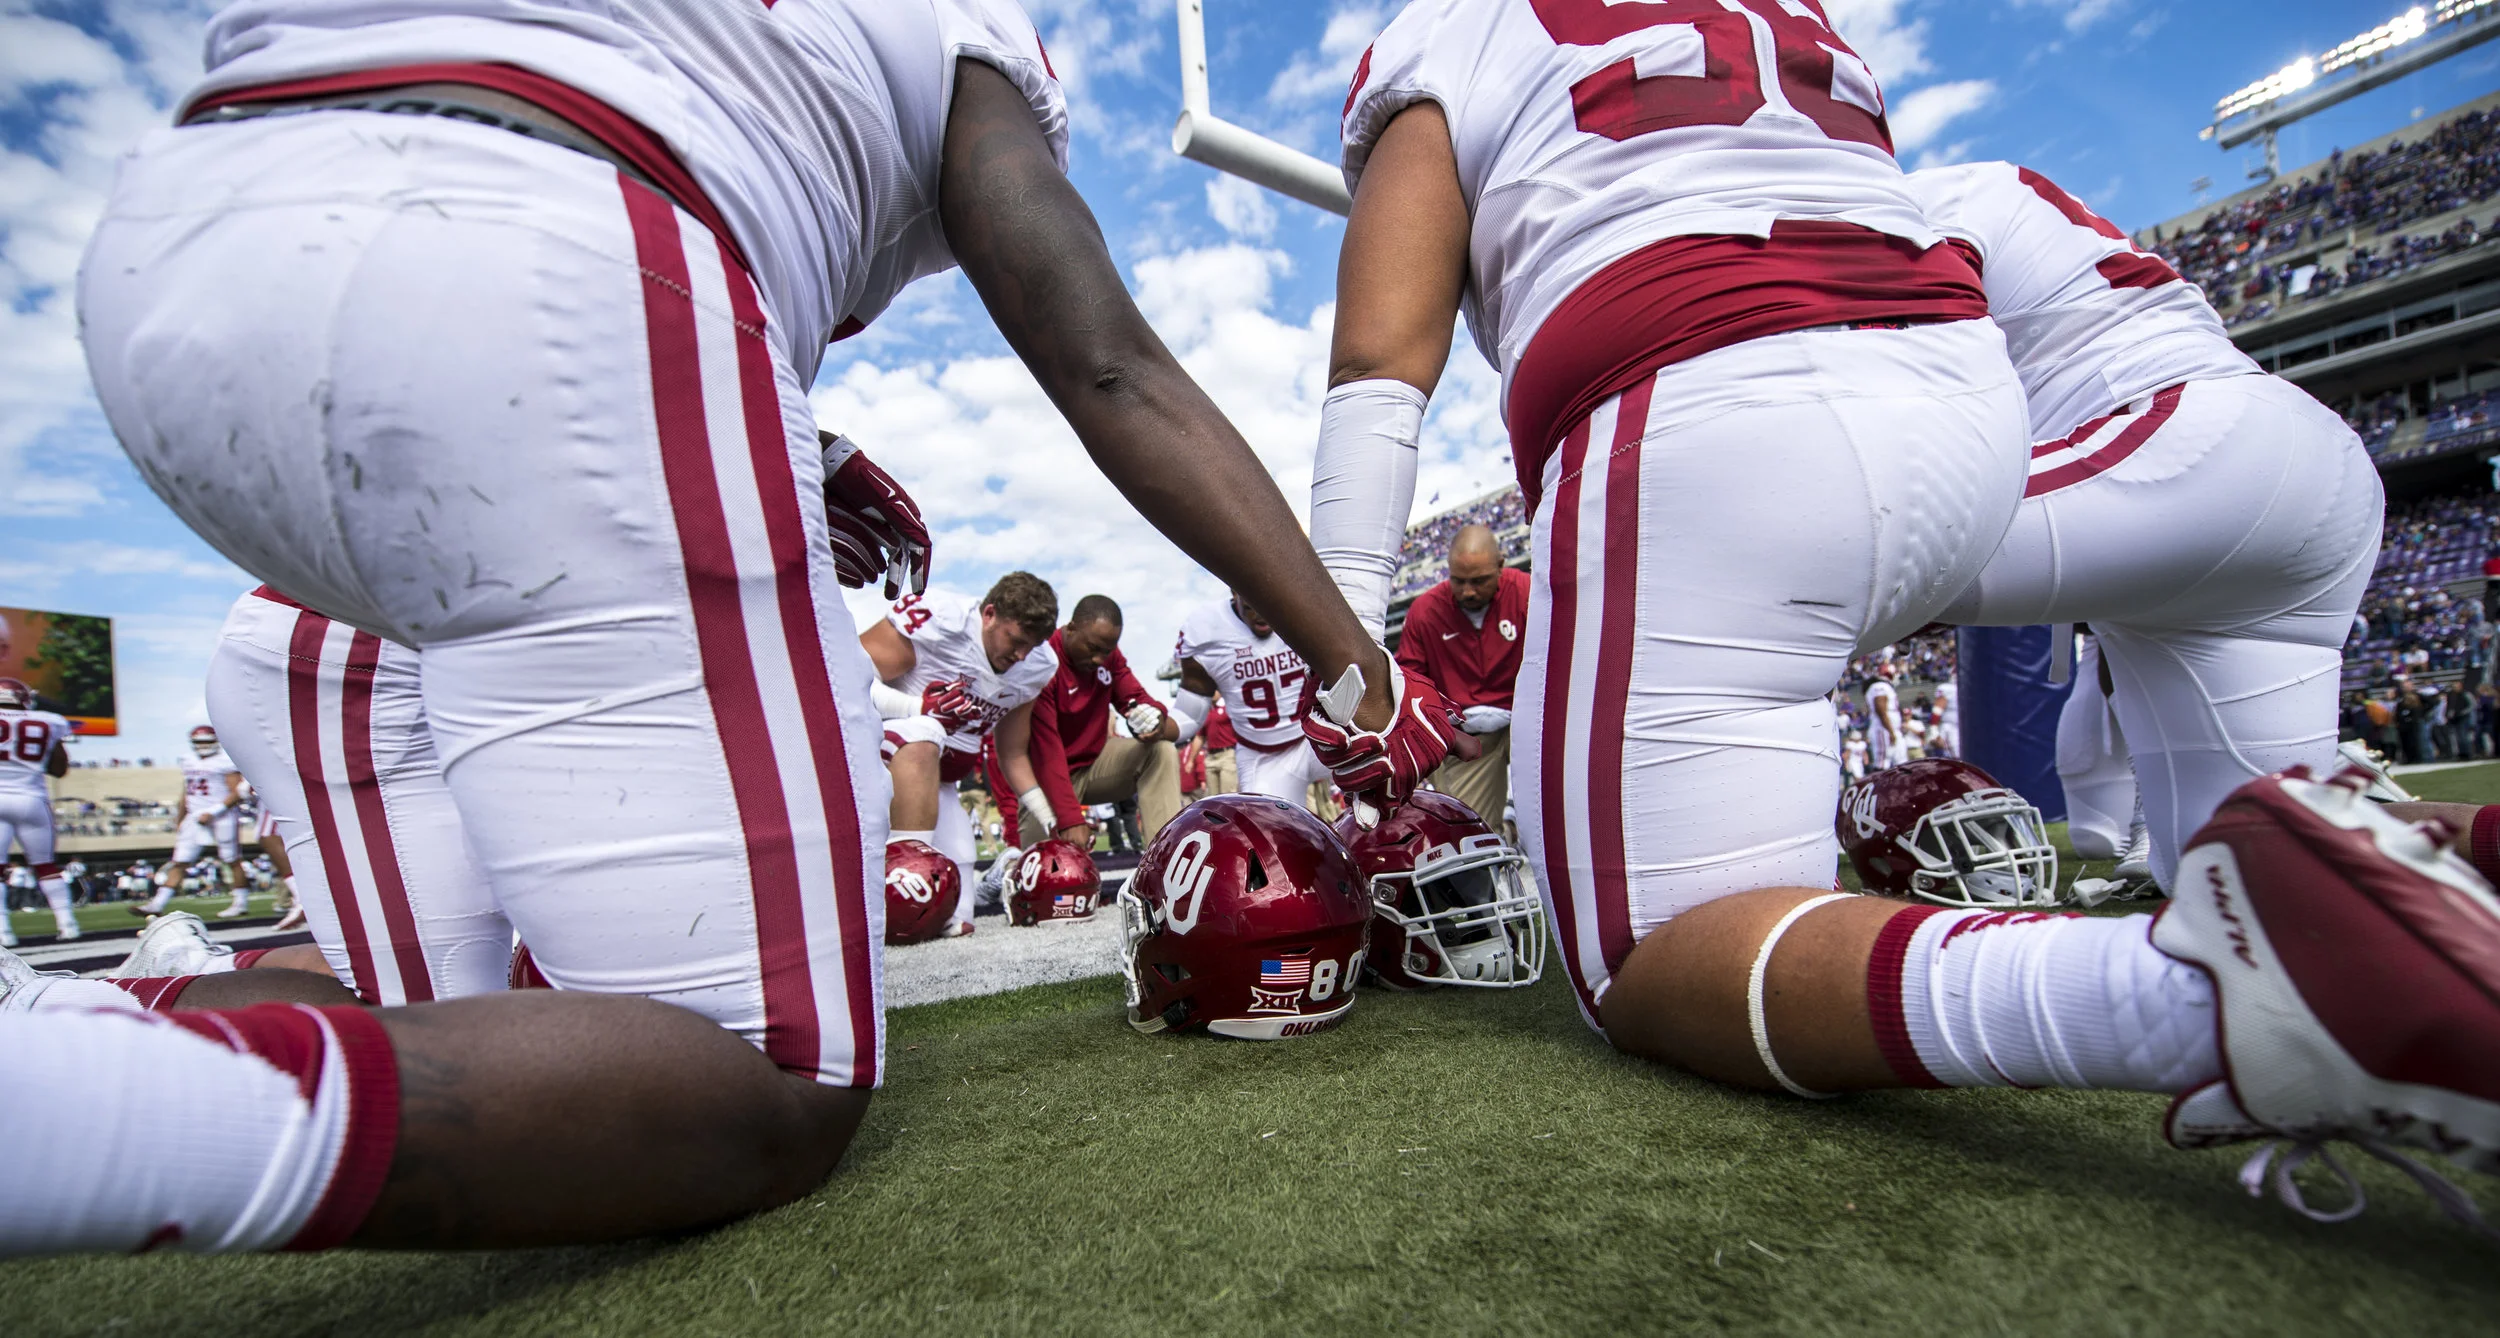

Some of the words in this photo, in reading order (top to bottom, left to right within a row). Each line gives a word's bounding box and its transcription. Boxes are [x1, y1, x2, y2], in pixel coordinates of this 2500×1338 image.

[1499, 620, 1517, 641] OU
[1096, 665, 1112, 685] OU
[1241, 670, 1305, 730] 97
[1426, 849, 1443, 862] NIKE
[1020, 851, 1042, 892] OU
[1163, 830, 1216, 935] OU
[1074, 894, 1097, 913] 94
[1309, 949, 1363, 1002] 80
[1247, 986, 1304, 1014] XII
